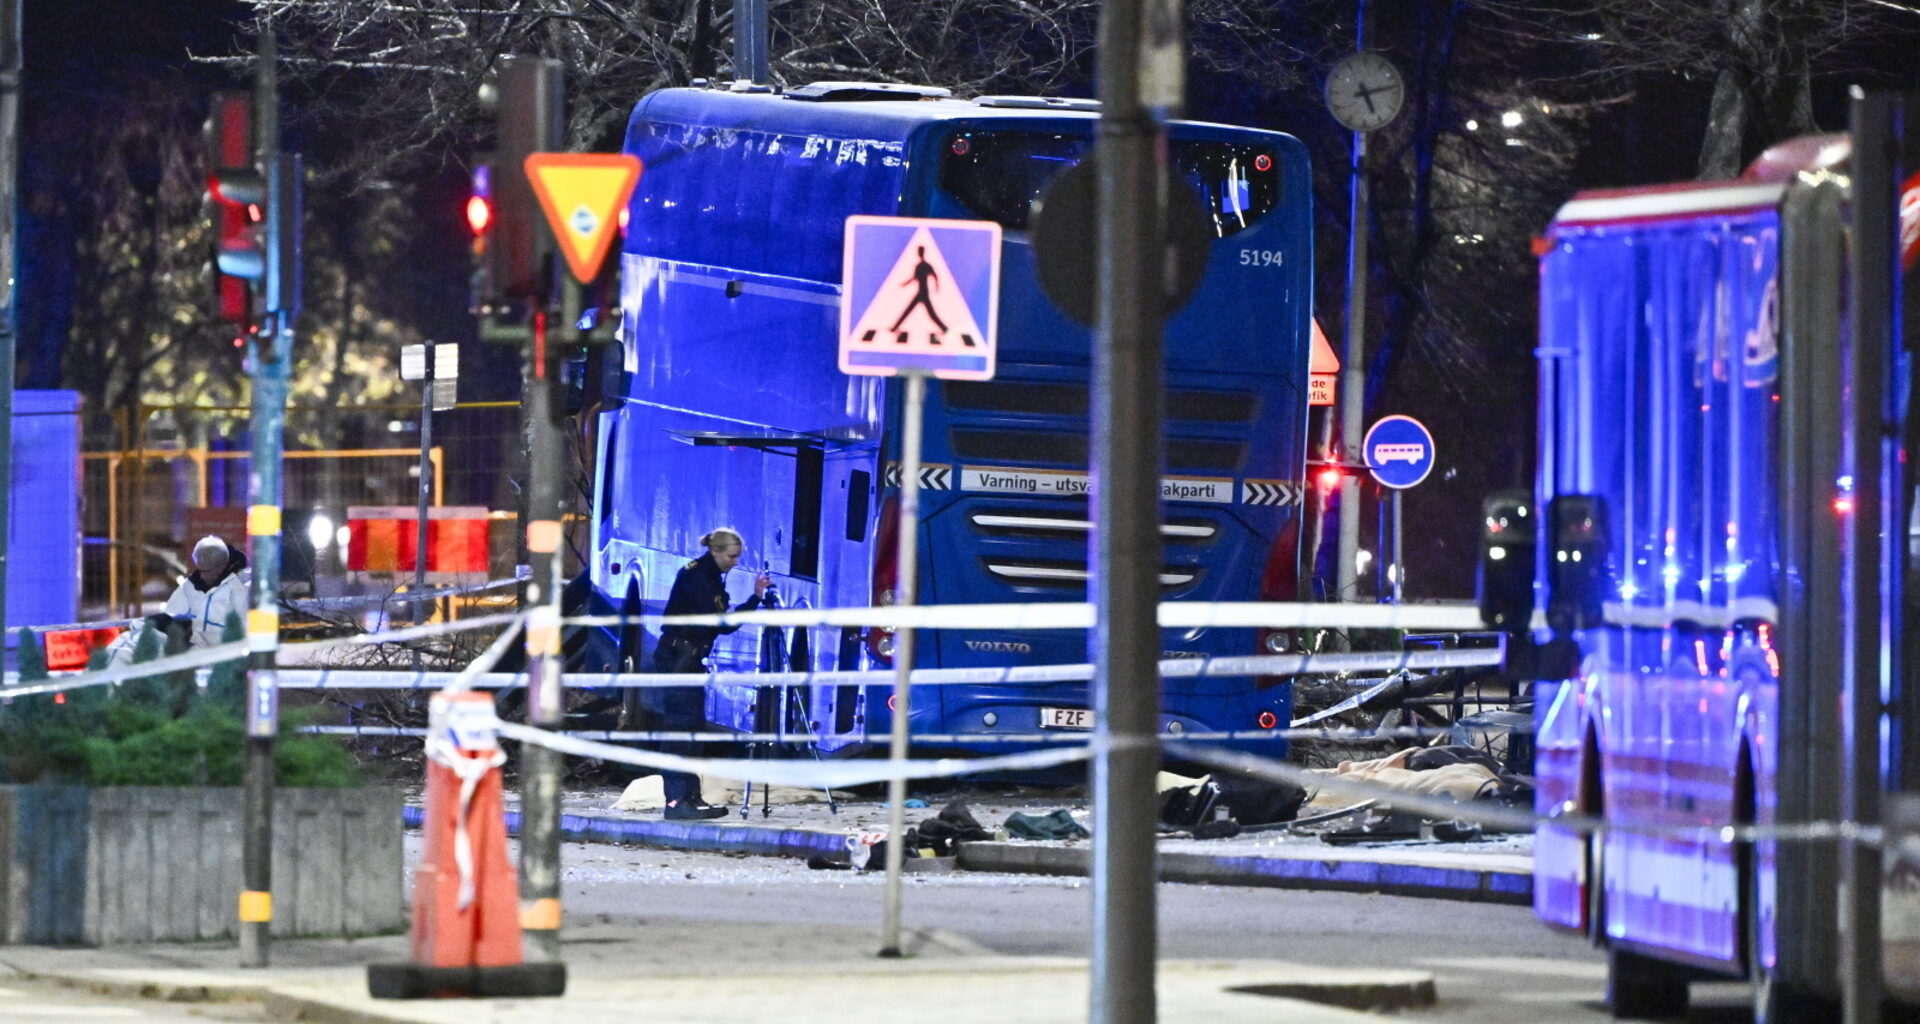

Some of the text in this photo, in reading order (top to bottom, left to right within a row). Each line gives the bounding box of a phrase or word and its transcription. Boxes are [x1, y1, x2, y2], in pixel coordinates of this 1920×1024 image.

[1240, 249, 1282, 267] 5194
[980, 473, 1037, 492] Varning
[964, 640, 1031, 653] VOLVO
[1055, 711, 1085, 726] FZF
